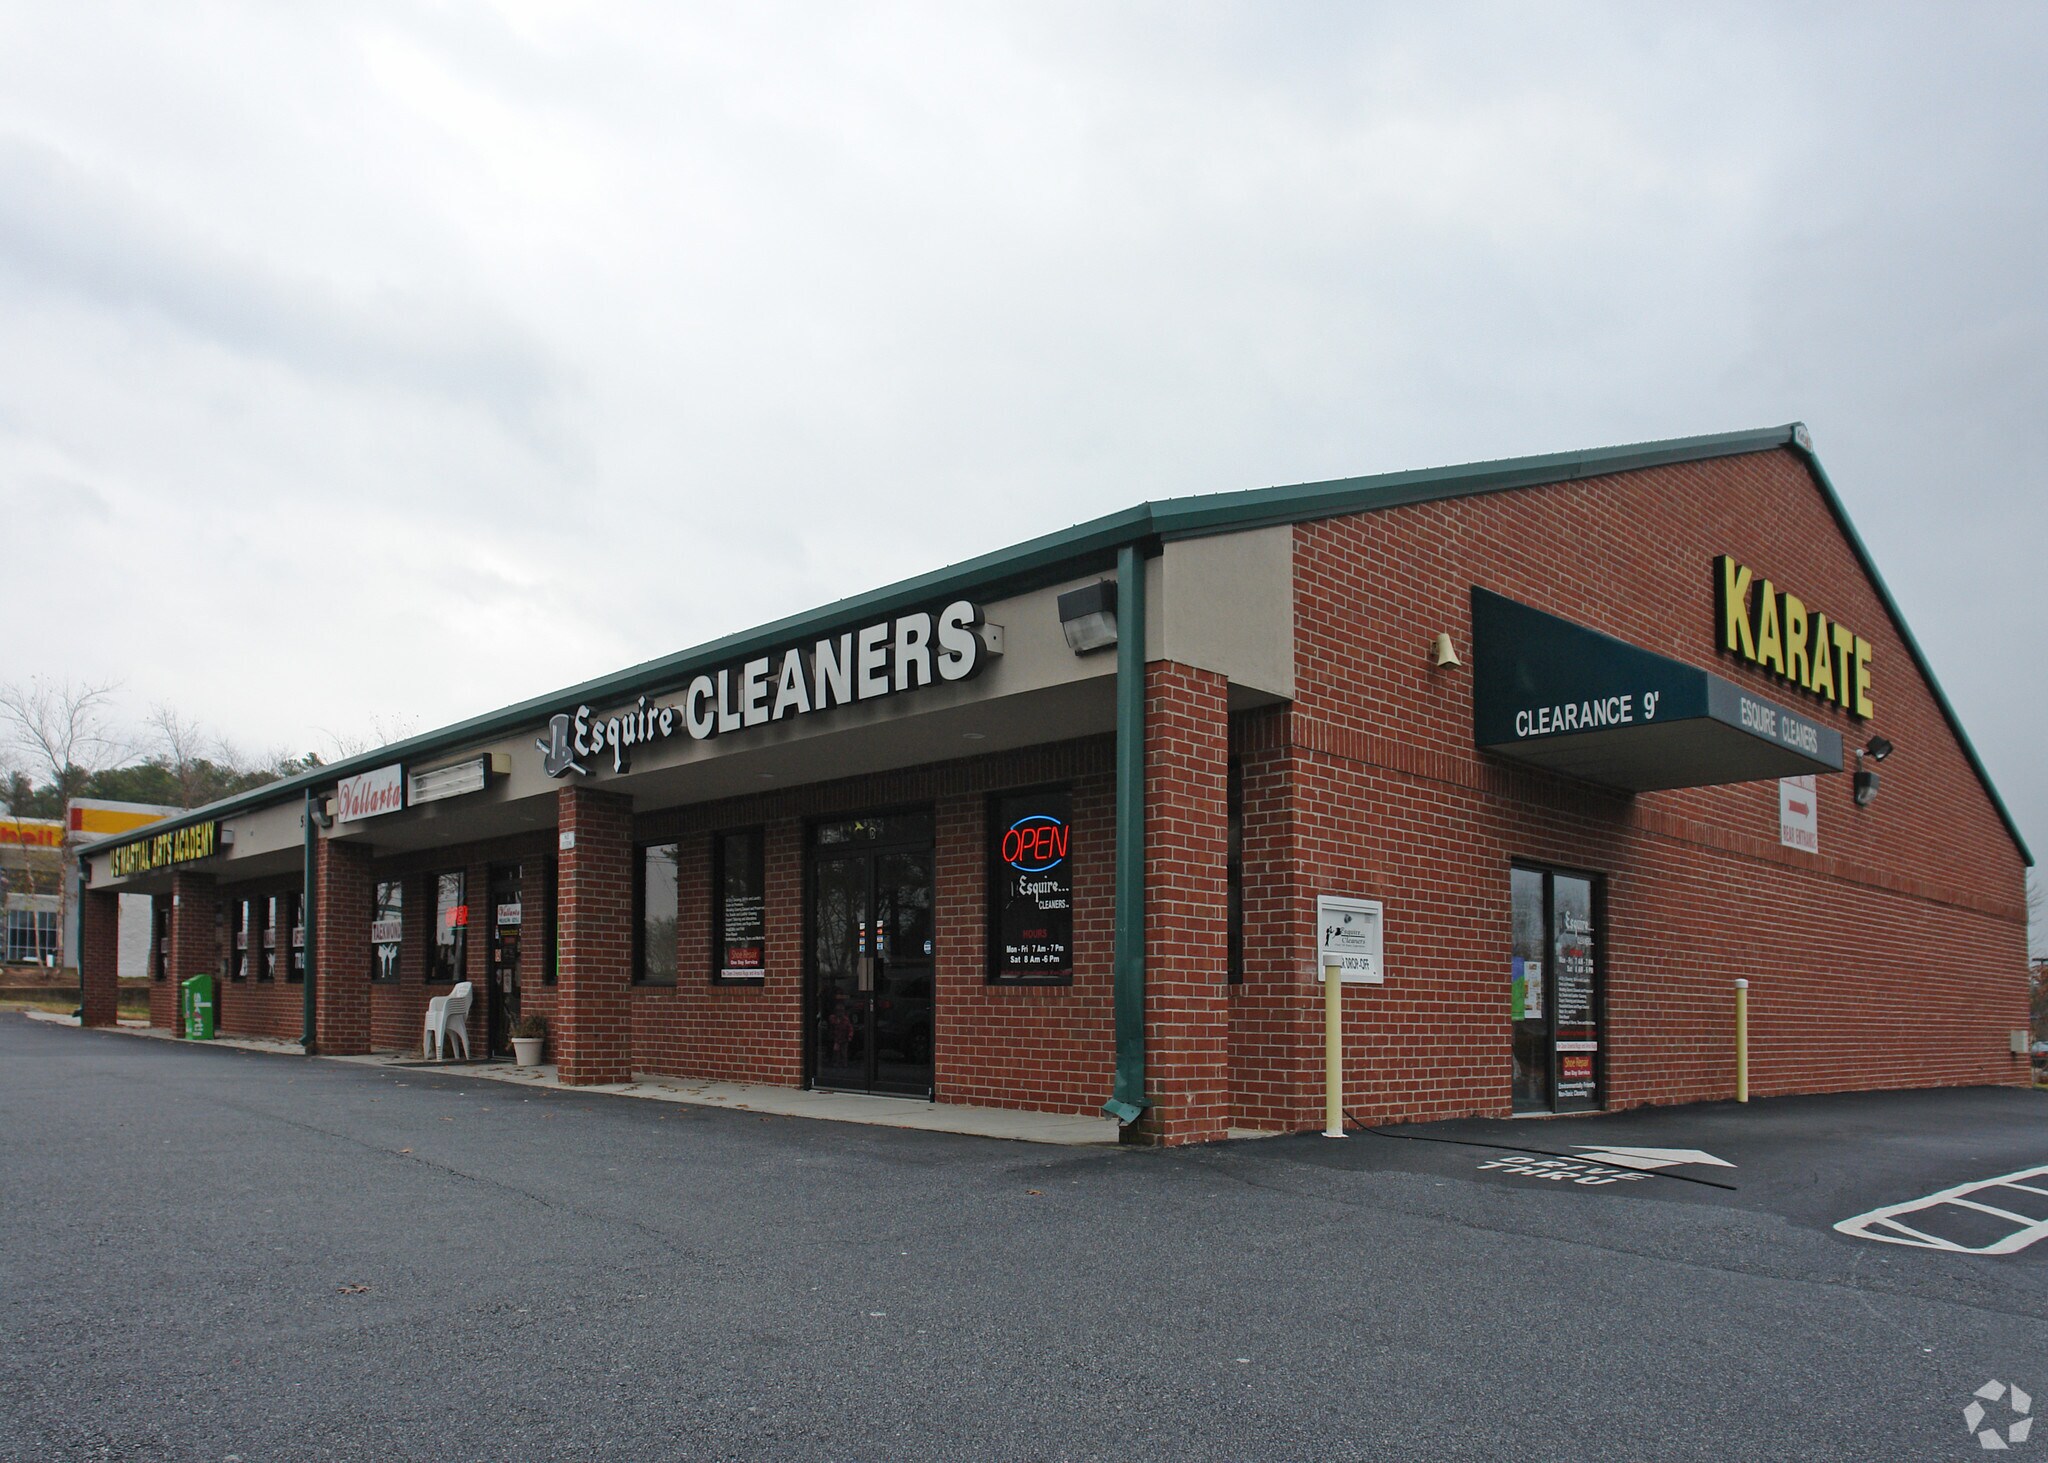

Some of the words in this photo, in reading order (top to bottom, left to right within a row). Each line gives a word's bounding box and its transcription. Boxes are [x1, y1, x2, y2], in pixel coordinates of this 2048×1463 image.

[1716, 554, 1873, 720] KARATE
[574, 694, 675, 774] Esquire
[685, 600, 978, 740] CLEANERS
[1515, 694, 1633, 738] CLEARANCE
[1644, 690, 1660, 721] 9'
[1740, 697, 1778, 737] ESQUIRE
[1781, 715, 1818, 755] CLEANERS
[120, 839, 151, 876] MARTIAL
[151, 831, 172, 870] ARTS
[173, 820, 215, 864] ACADEMY
[1001, 824, 1070, 863] OPEN
[1020, 944, 1029, 953] Fri
[1031, 944, 1036, 953] 7
[1022, 928, 1048, 939] HOURS
[1010, 955, 1021, 964] Sat
[1477, 1160, 1617, 1186] THRU
